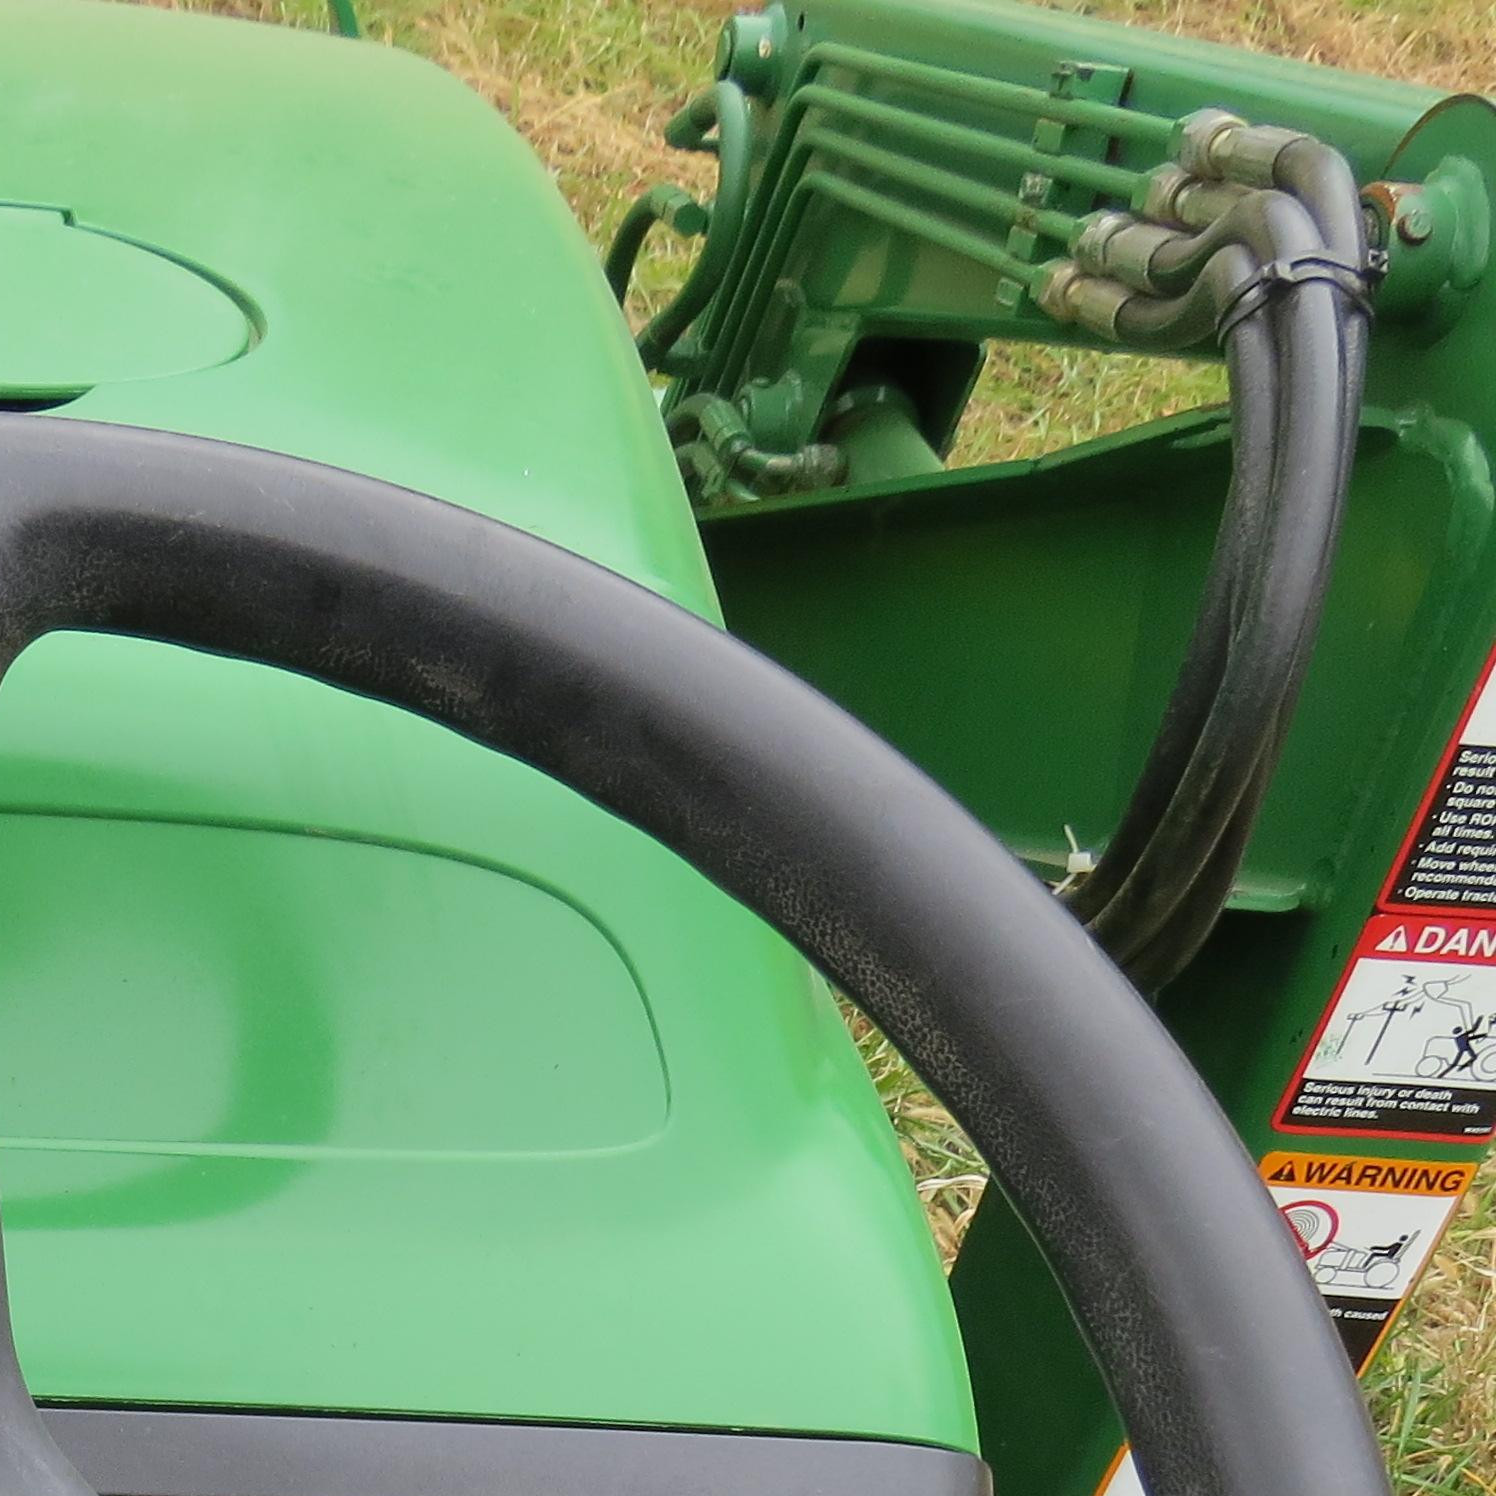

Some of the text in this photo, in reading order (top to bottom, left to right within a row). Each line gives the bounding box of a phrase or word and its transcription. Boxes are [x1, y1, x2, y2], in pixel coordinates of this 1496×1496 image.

[1452, 766, 1495, 778] result
[1453, 781, 1496, 796] Do no
[1446, 797, 1495, 810] square
[1439, 811, 1467, 824] Use
[1432, 826, 1495, 839] all times.
[1424, 841, 1455, 854] Add
[1417, 857, 1496, 873] Move whee
[1404, 886, 1460, 901] Operate
[1303, 1082, 1453, 1100] Serious injury or death
[1298, 1095, 1481, 1114] can result from contact with
[1292, 1105, 1379, 1120] electric lines.
[1305, 1161, 1465, 1192] WARNING
[1344, 1310, 1389, 1320] caused
